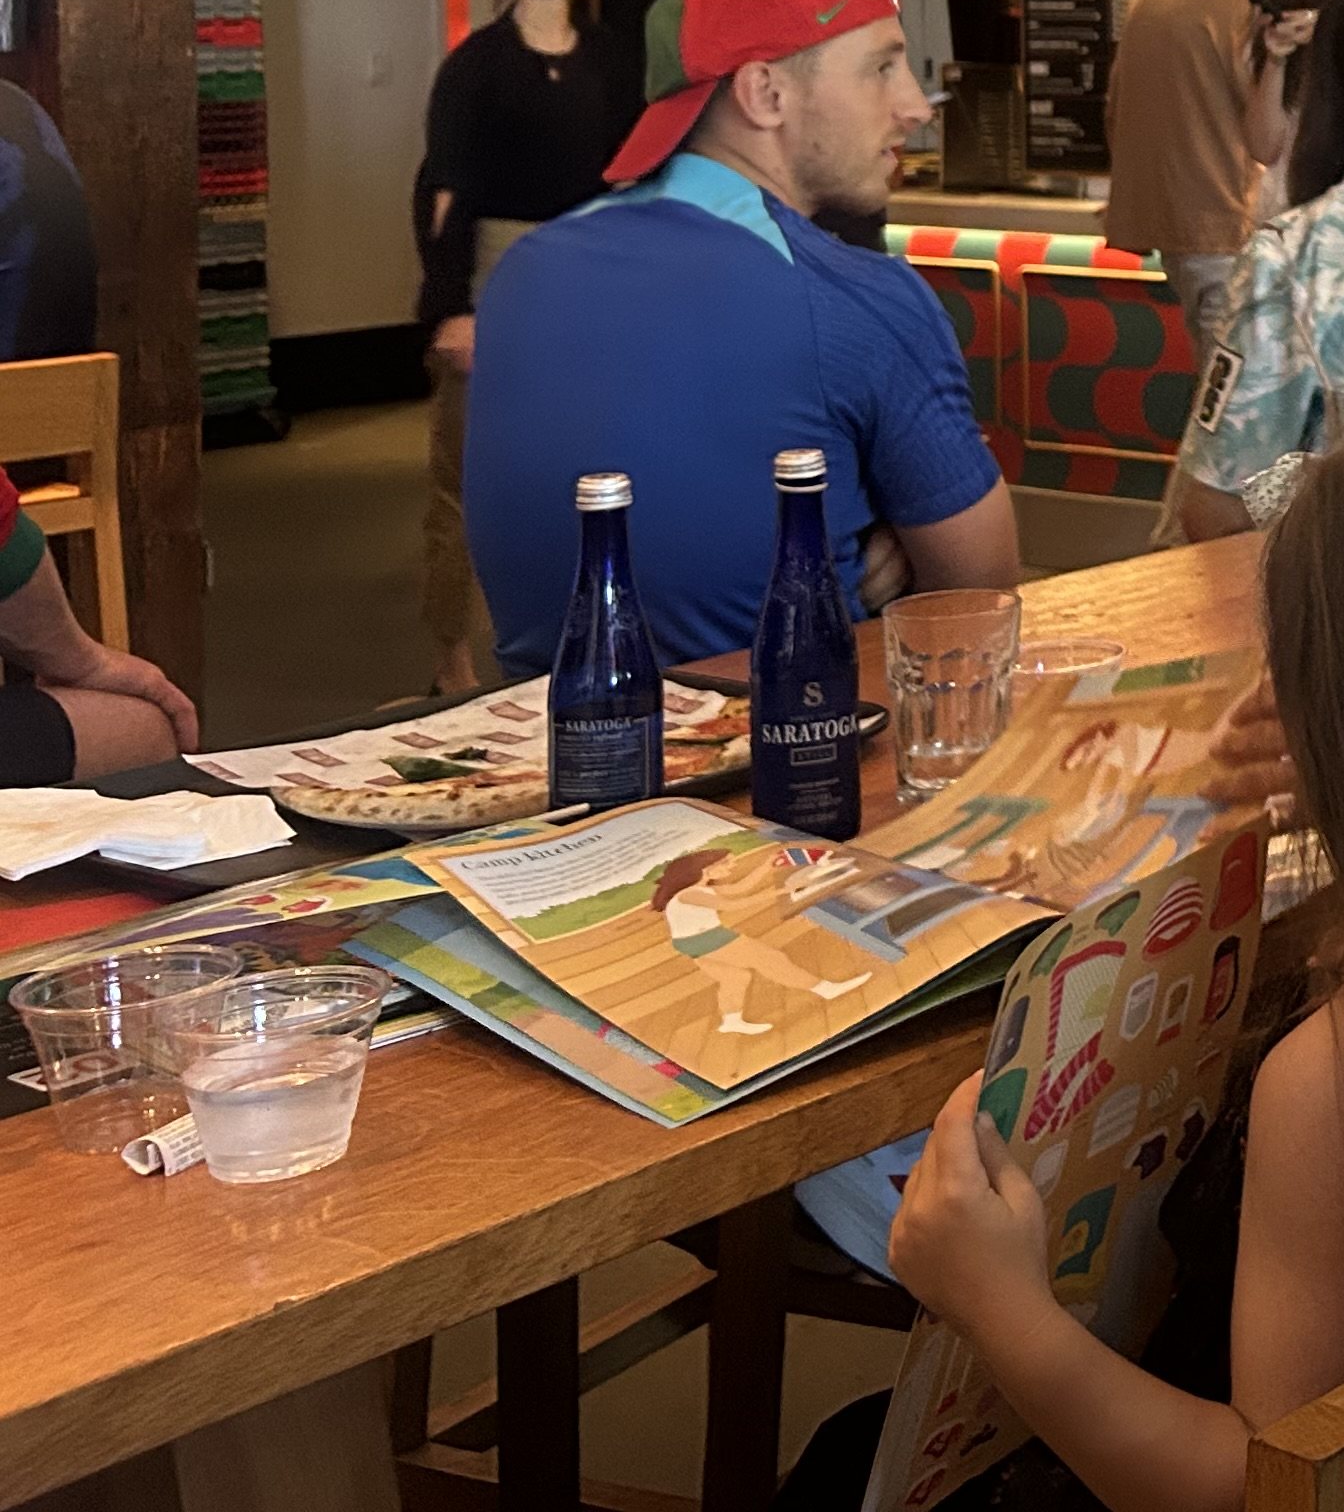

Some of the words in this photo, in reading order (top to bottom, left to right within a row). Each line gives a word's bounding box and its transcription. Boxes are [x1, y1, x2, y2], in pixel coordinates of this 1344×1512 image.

[565, 716, 632, 733] SARATOGA
[761, 714, 859, 744] SARATOGA
[461, 853, 522, 872] Camp
[524, 834, 603, 862] kitchen
